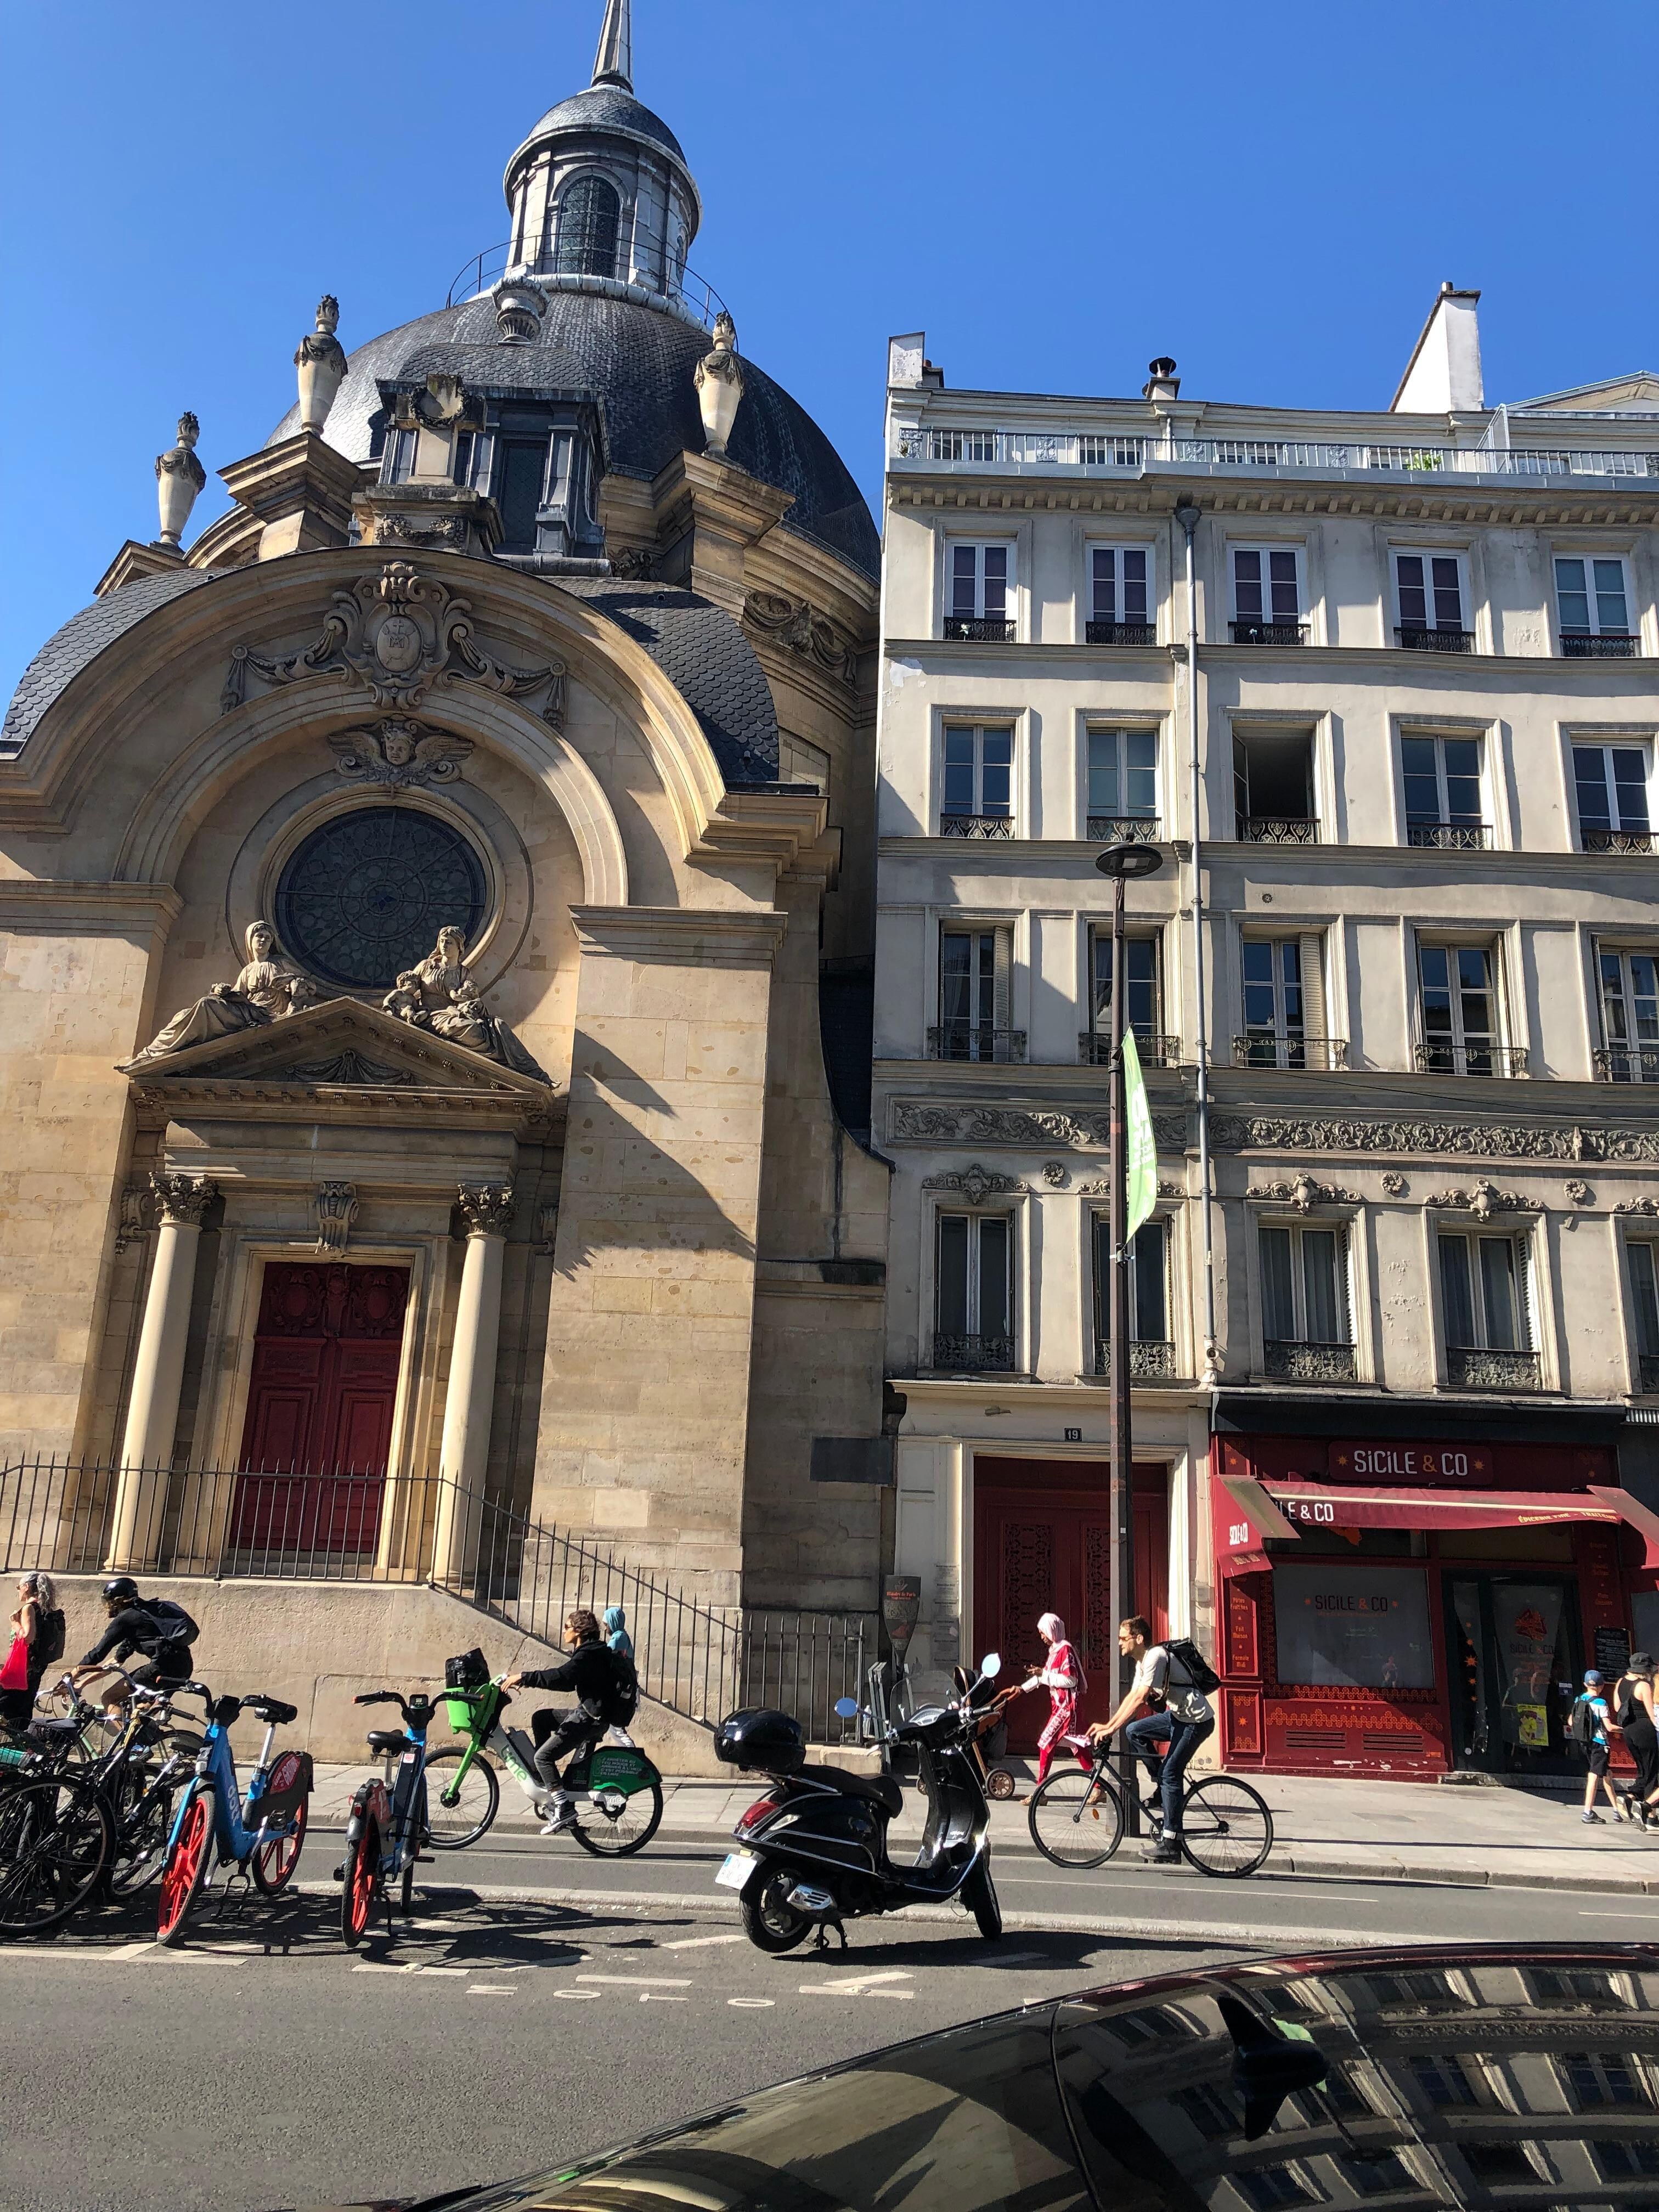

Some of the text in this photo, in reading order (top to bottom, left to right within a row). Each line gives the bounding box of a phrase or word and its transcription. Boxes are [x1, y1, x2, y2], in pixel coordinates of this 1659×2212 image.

[1068, 1430, 1078, 1440] 19
[1423, 1455, 1437, 1472] &
[1441, 1453, 1468, 1476] CO
[1275, 1501, 1334, 1522] LE & CO
[1359, 1598, 1369, 1610] &
[1372, 1596, 1388, 1612] CO
